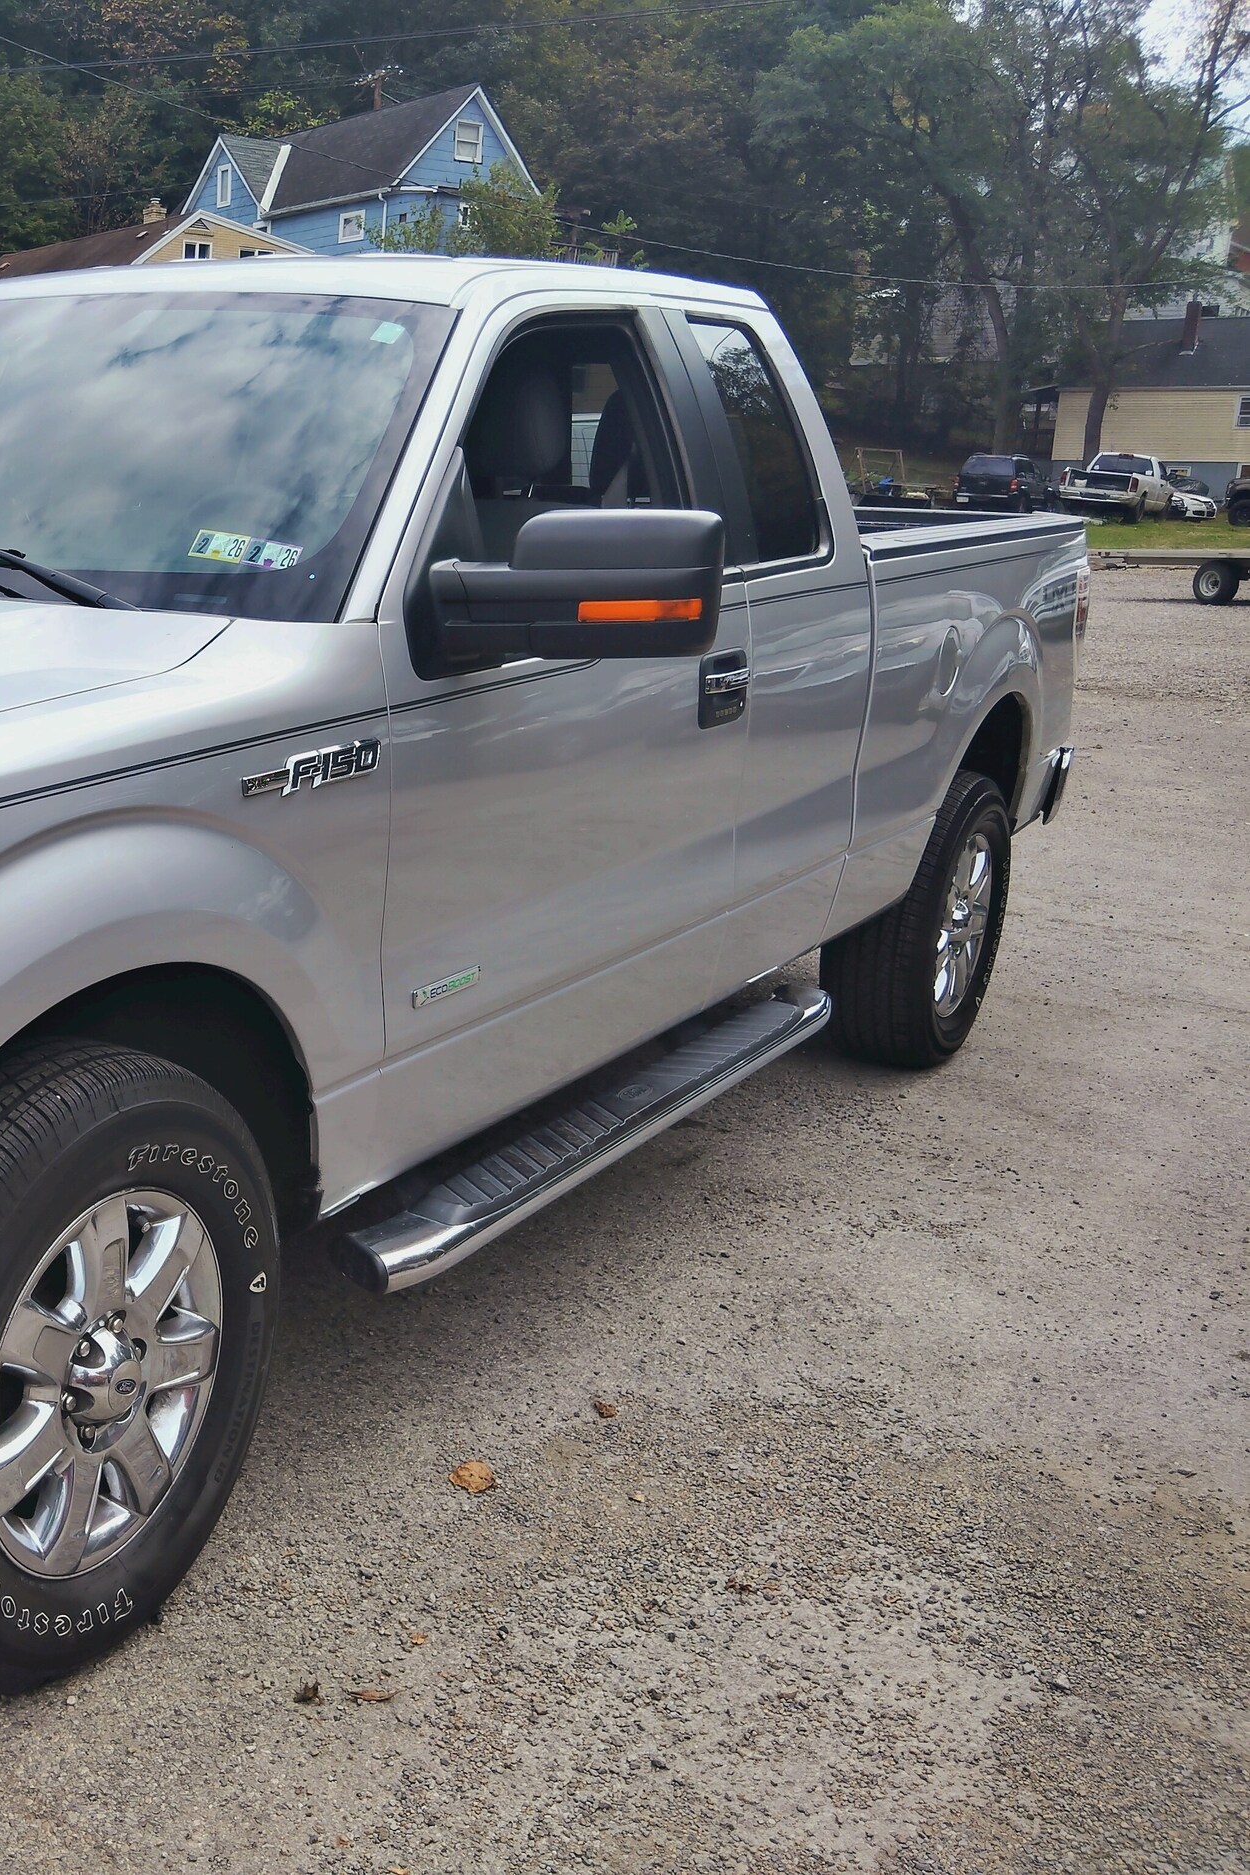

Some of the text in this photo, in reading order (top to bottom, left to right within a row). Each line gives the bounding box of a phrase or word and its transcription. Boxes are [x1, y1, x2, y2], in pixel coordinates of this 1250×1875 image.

[227, 538, 246, 558] 26
[280, 548, 298, 568] 26
[127, 1143, 260, 1250] Firestone
